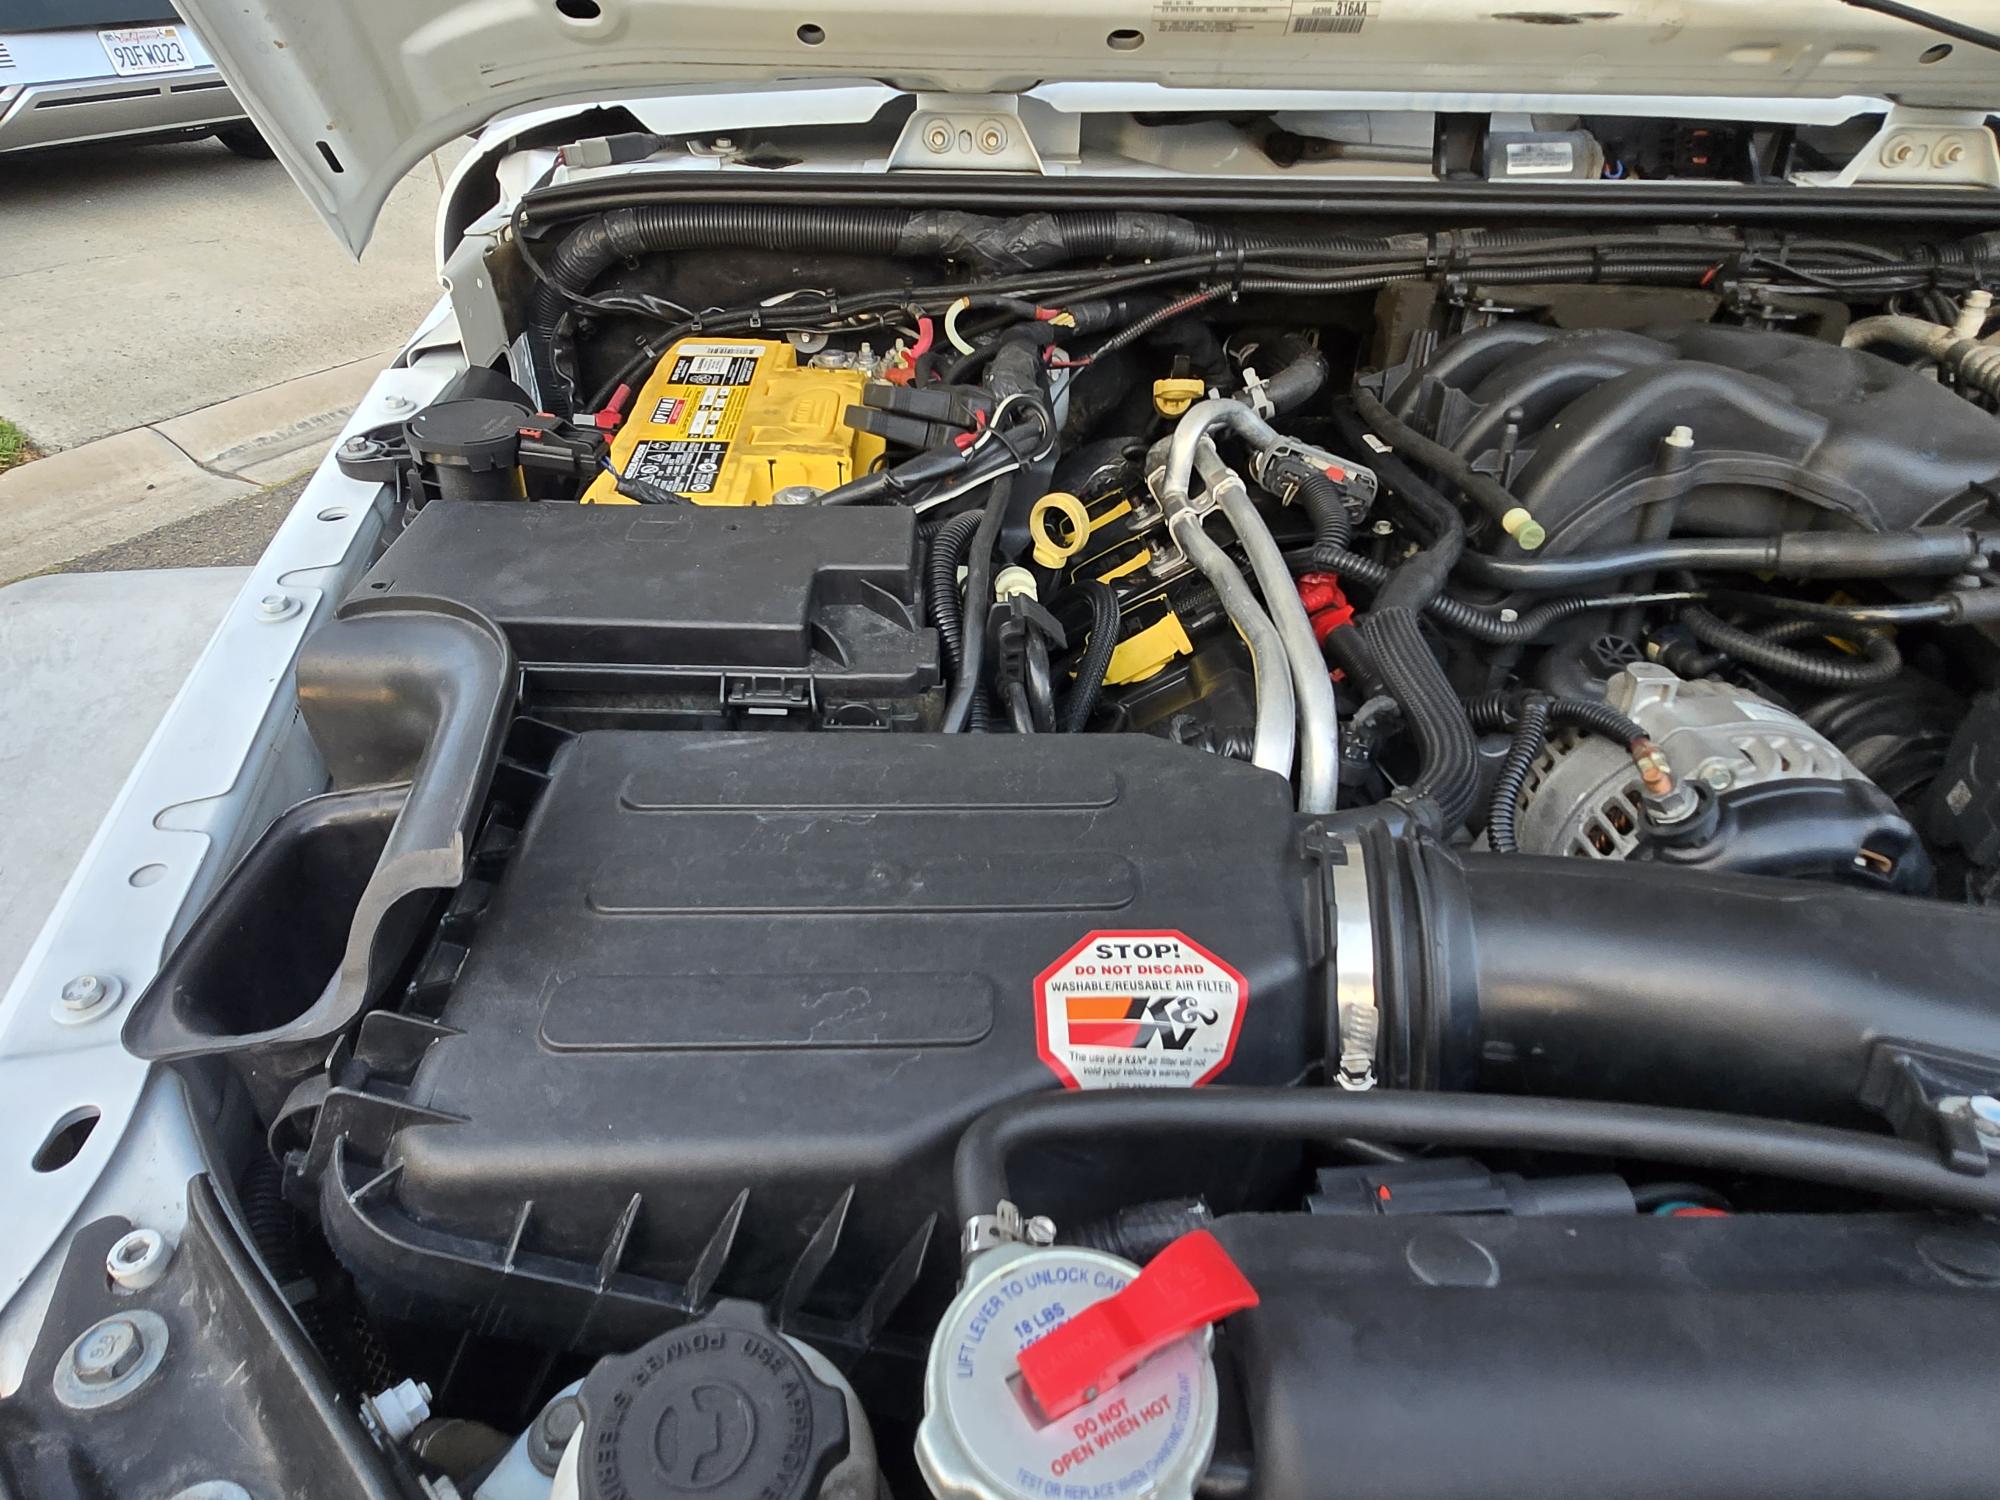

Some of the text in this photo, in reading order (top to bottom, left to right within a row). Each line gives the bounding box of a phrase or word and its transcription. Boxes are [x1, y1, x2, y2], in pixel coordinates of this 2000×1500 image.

[1335, 1, 1367, 16] 316AA
[114, 42, 184, 68] 9DFW023
[1096, 943, 1180, 959] STOP!
[1075, 964, 1205, 975] DO NOT DISCARD
[1051, 979, 1233, 993] WASHABLE/REUSABLE AIR FILTER
[1070, 1050, 1087, 1062] The
[957, 1343, 975, 1379] LIFT
[969, 1294, 1005, 1345] LEVER
[1000, 1280, 1024, 1301] TO
[1025, 1267, 1089, 1290] UNLOCK
[1013, 1318, 1033, 1339] 18
[1033, 1301, 1067, 1329] LBS
[632, 1331, 727, 1387] POWER
[743, 1338, 788, 1377] USE
[1073, 1397, 1130, 1441] DO NOT
[1050, 1394, 1172, 1478] OPEN WHEN HOT
[1064, 1482, 1115, 1500] REPLACE
